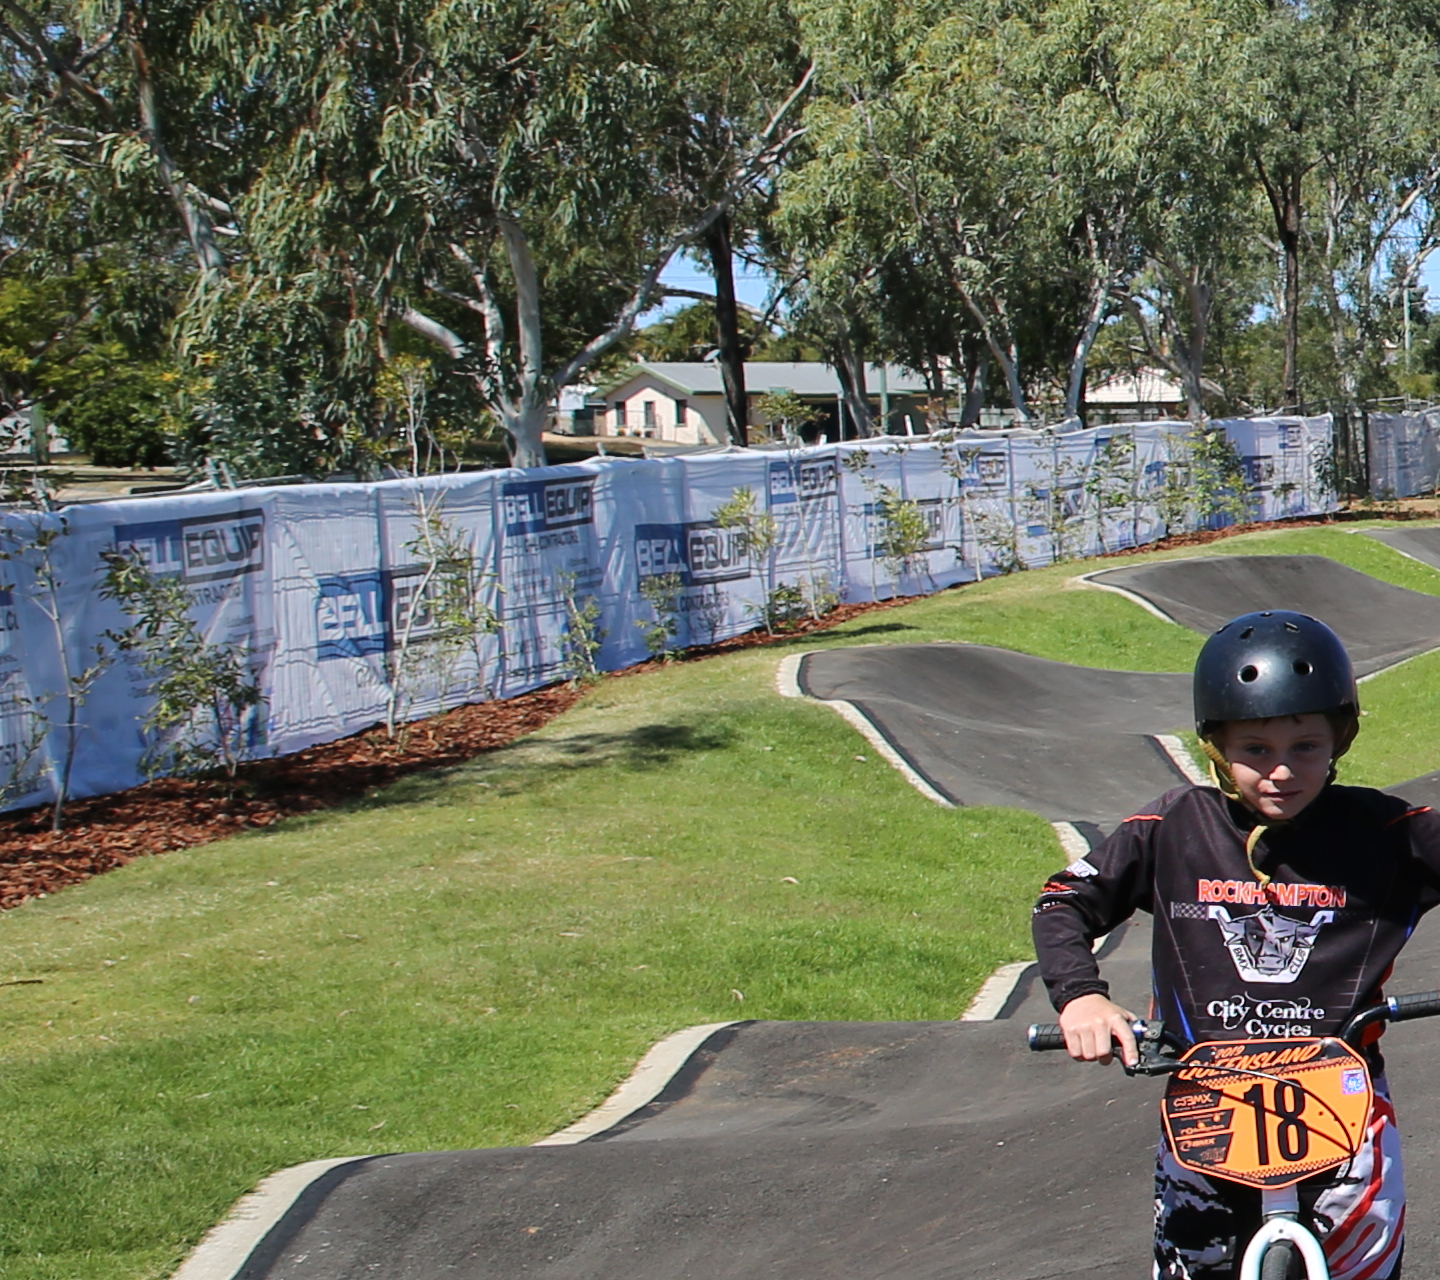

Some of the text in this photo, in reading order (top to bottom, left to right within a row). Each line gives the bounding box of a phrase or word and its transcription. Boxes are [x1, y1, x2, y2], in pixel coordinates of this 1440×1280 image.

[547, 482, 592, 520] EQUIP
[184, 524, 262, 569] EQUIP
[689, 525, 749, 571] EQUIP
[1197, 879, 1346, 907] ROCKHAMPTON
[1232, 947, 1251, 971] BMX
[1290, 949, 1307, 974] CLUB
[1207, 996, 1325, 1029] City Centre
[1245, 1019, 1312, 1038] Cycles
[1244, 1078, 1309, 1166] 18
